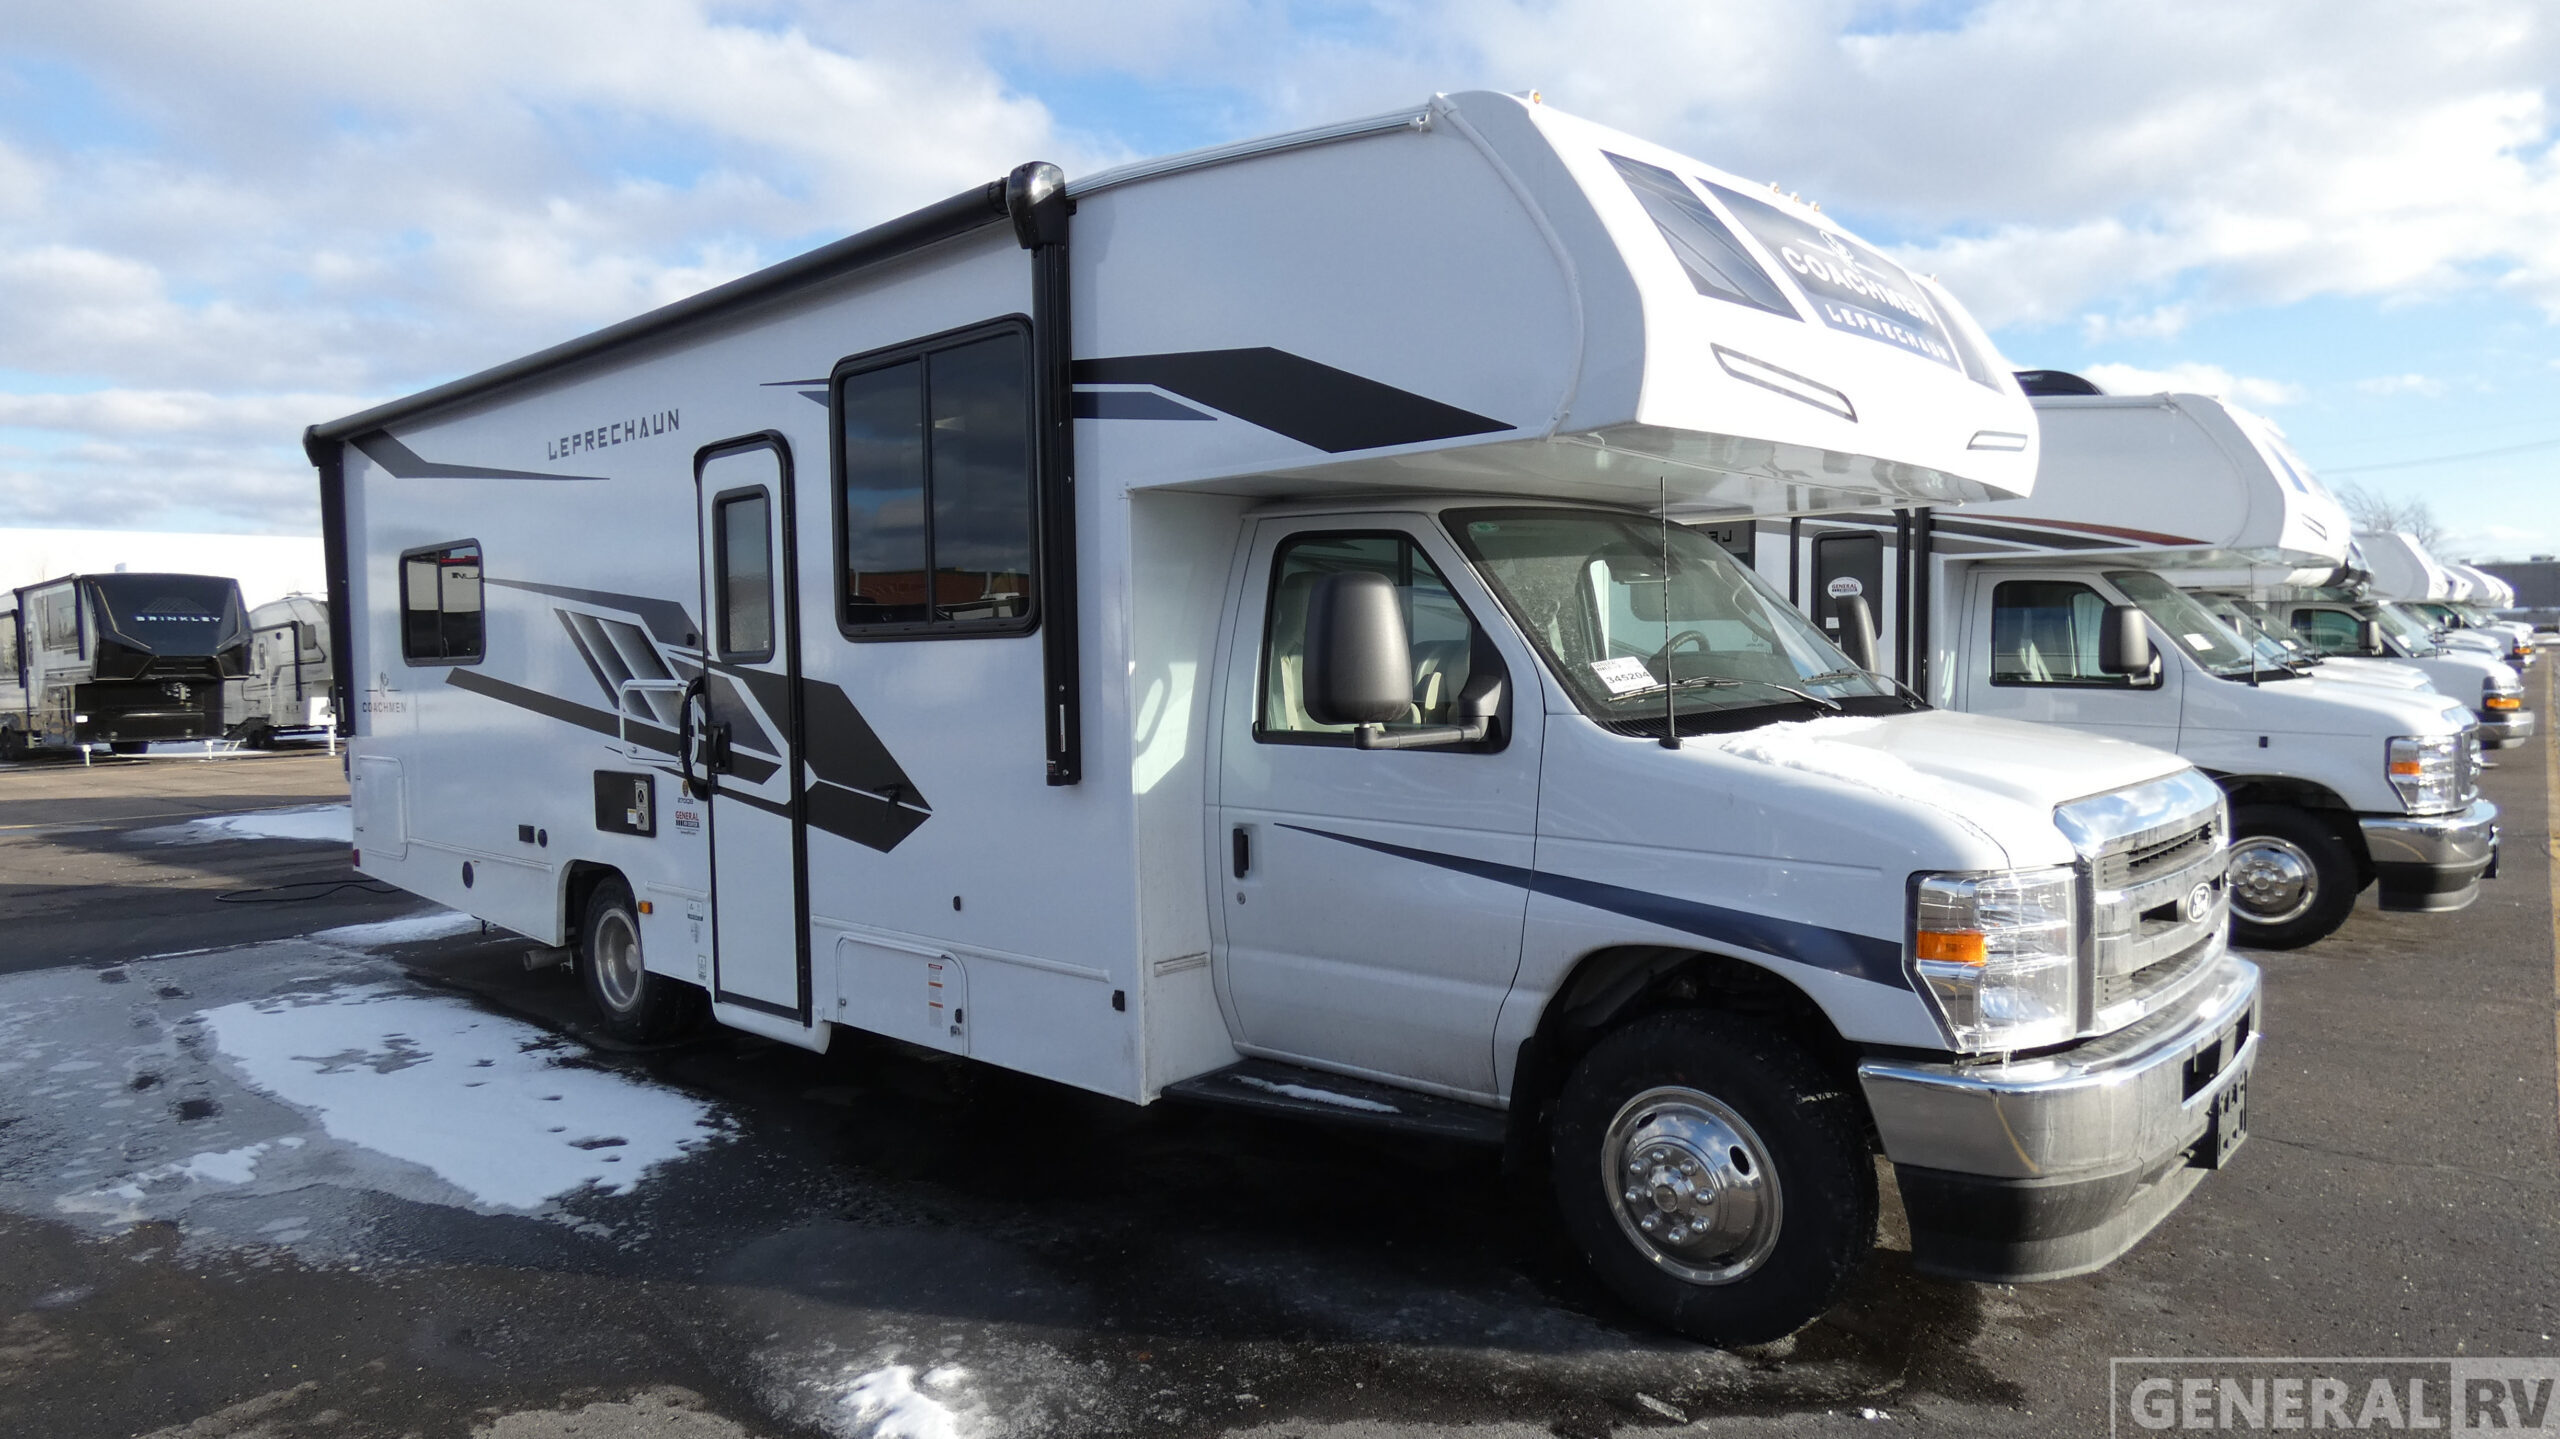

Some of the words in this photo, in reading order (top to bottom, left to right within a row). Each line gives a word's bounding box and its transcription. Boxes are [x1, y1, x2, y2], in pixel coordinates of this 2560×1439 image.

[1781, 246, 1935, 325] COACHMEN
[1824, 303, 1950, 361] LEPRECHAUN
[548, 408, 680, 461] LEPRECHAUN
[1606, 671, 1650, 684] 345204
[362, 702, 407, 713] COACHMEN
[675, 810, 700, 821] GENERAL
